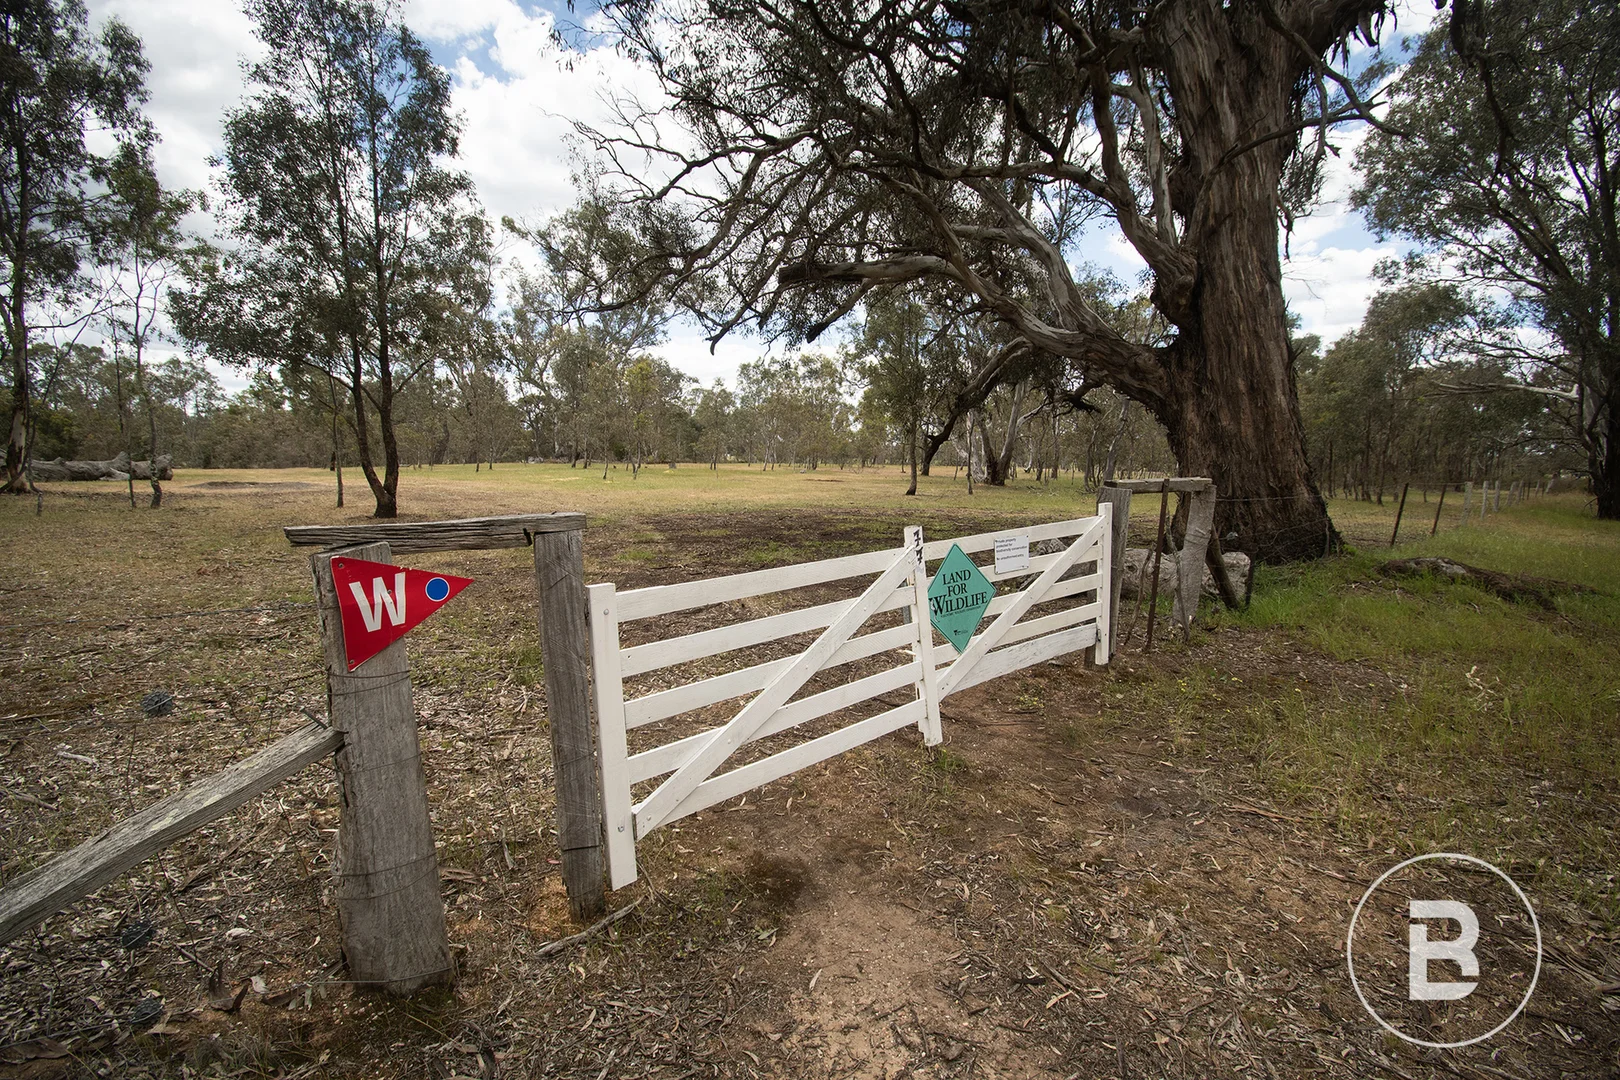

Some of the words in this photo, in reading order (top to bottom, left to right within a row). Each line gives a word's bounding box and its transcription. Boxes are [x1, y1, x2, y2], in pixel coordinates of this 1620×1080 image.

[942, 569, 971, 585] LAND
[947, 583, 968, 597] FOR
[348, 571, 405, 632] W
[928, 591, 988, 616] WILDLIFE
